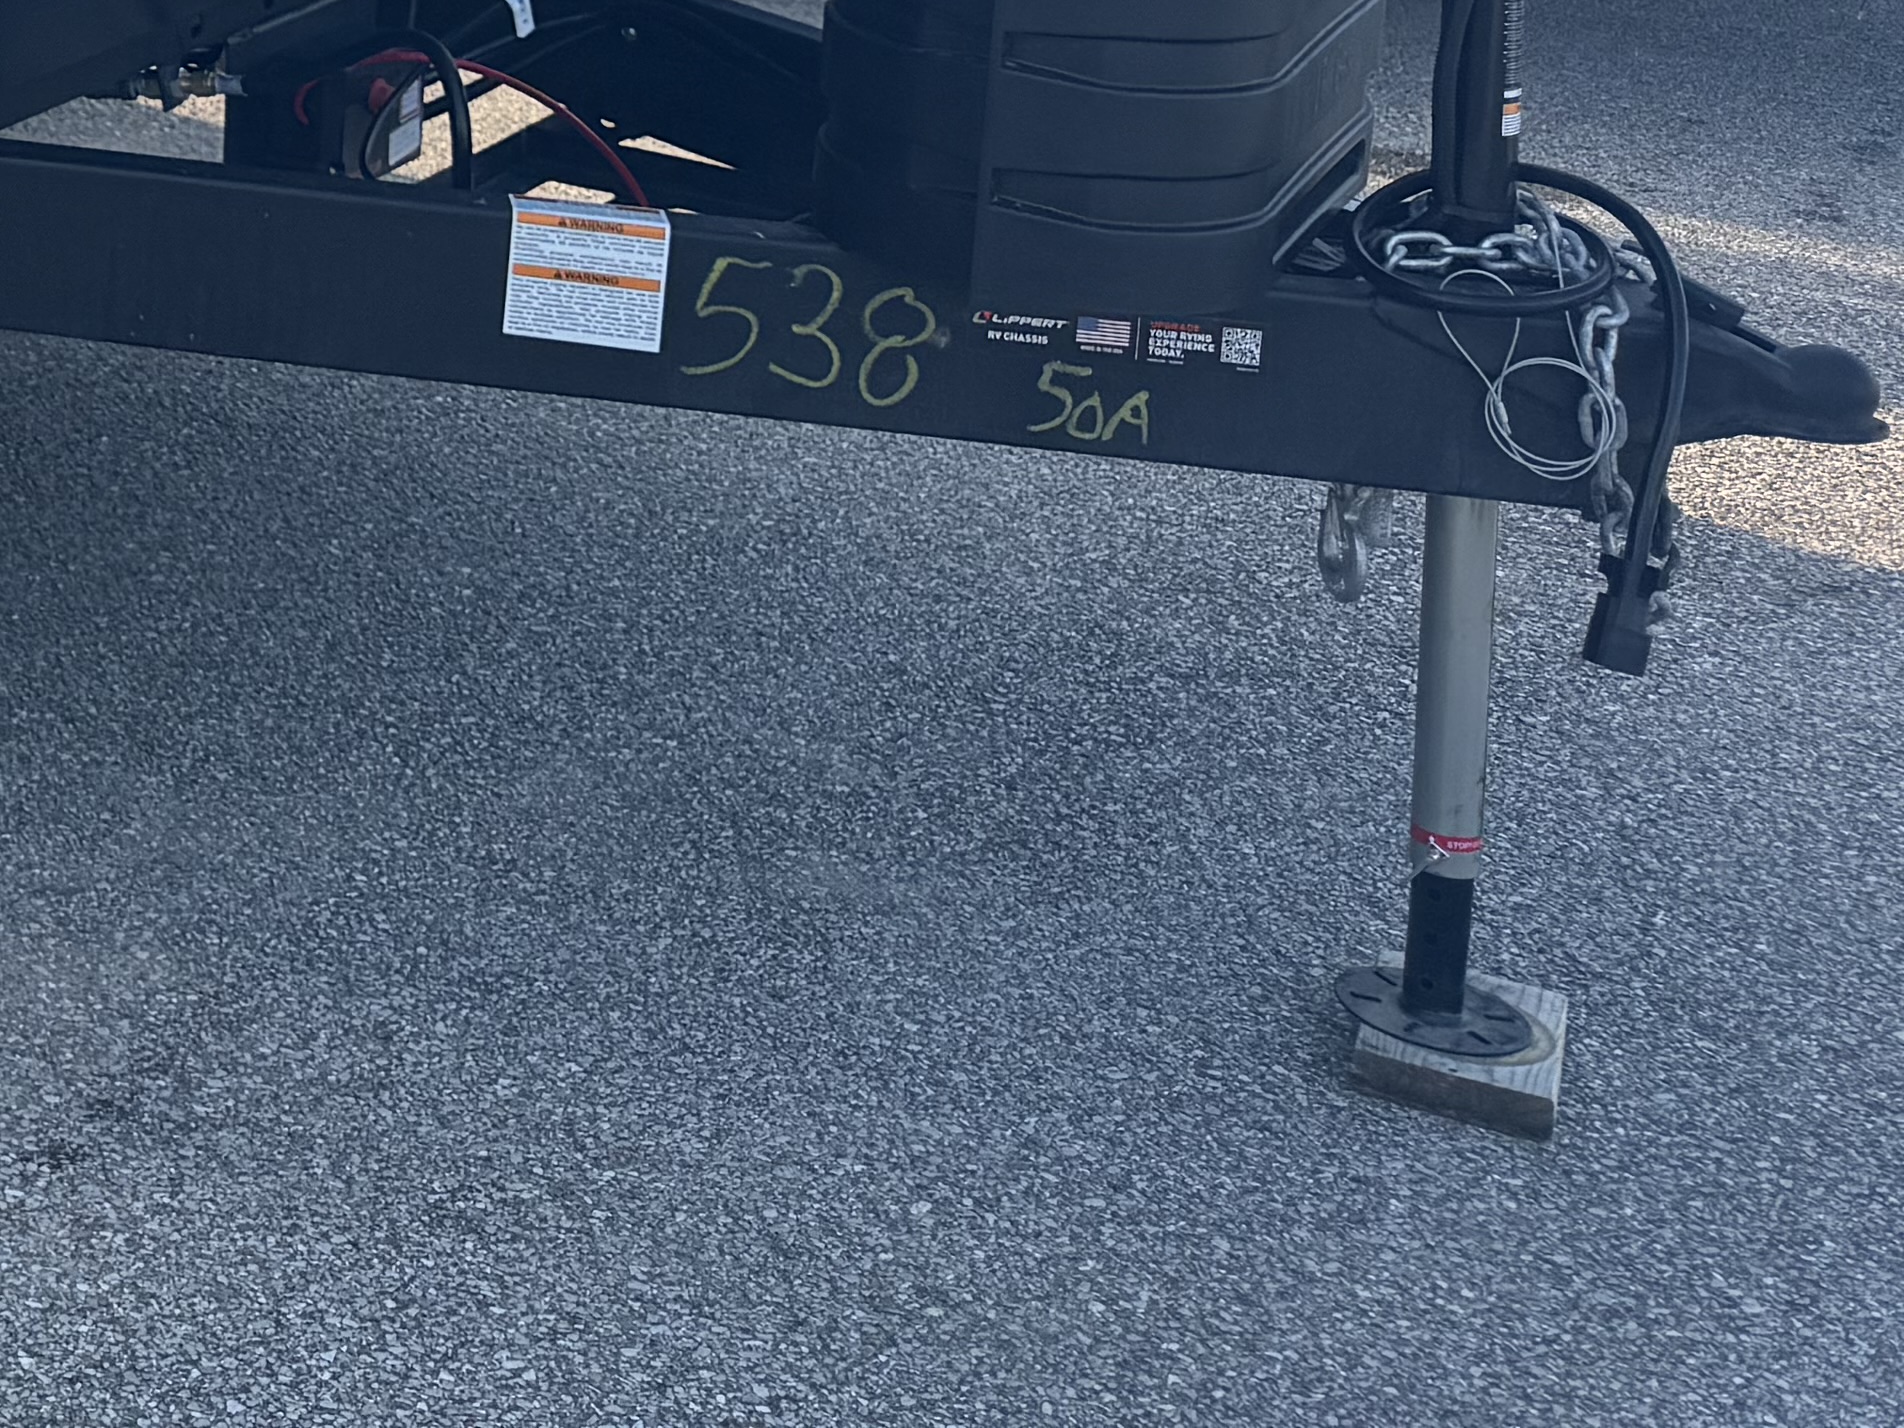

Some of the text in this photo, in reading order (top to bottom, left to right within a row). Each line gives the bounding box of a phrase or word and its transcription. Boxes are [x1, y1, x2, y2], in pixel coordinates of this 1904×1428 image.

[569, 217, 624, 233] WARNING
[565, 270, 619, 286] WARNING
[680, 257, 936, 406] 538
[987, 330, 1049, 345] RV CHASSIS
[1149, 328, 1213, 343] YOUR RVING
[1148, 337, 1215, 353] EXPERIENCE
[1027, 360, 1150, 444] 50A
